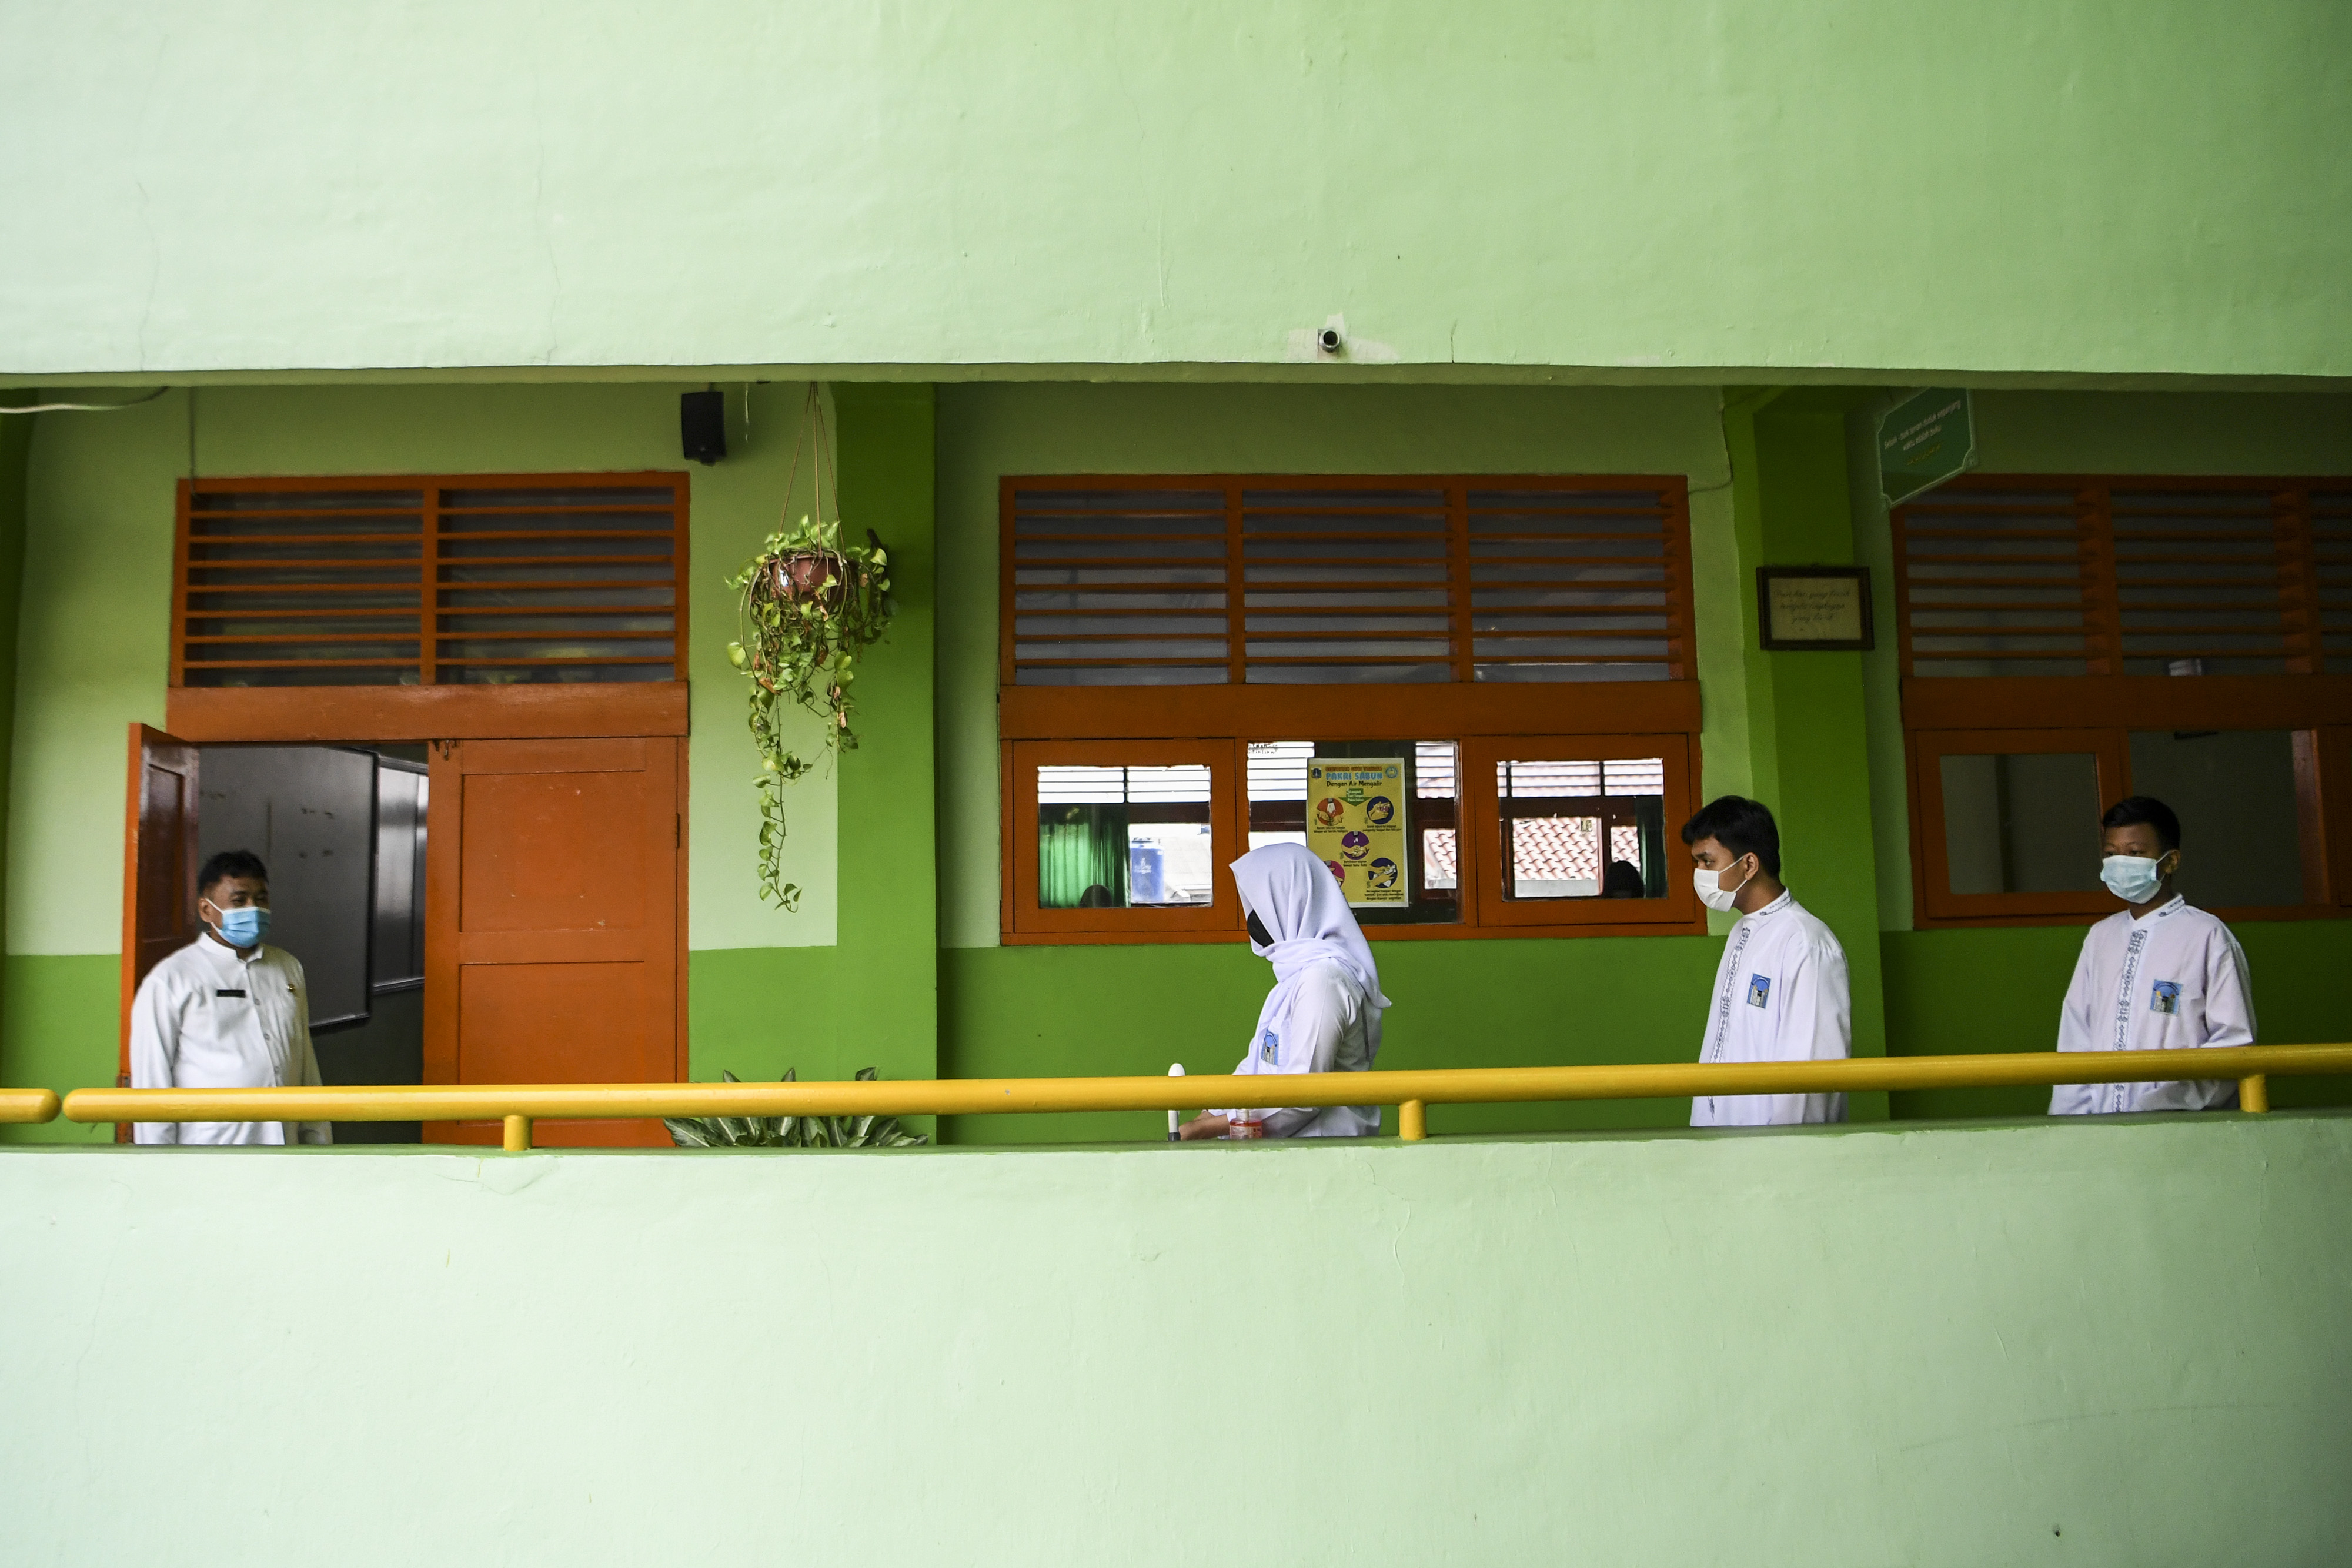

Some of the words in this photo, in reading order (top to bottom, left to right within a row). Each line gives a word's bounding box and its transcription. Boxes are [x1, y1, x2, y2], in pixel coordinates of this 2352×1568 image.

[1326, 771, 1352, 780] PAKAI
[1355, 771, 1384, 780] SABUN
[1327, 780, 1348, 788] Dengan
[1359, 780, 1382, 788] Mengalir
